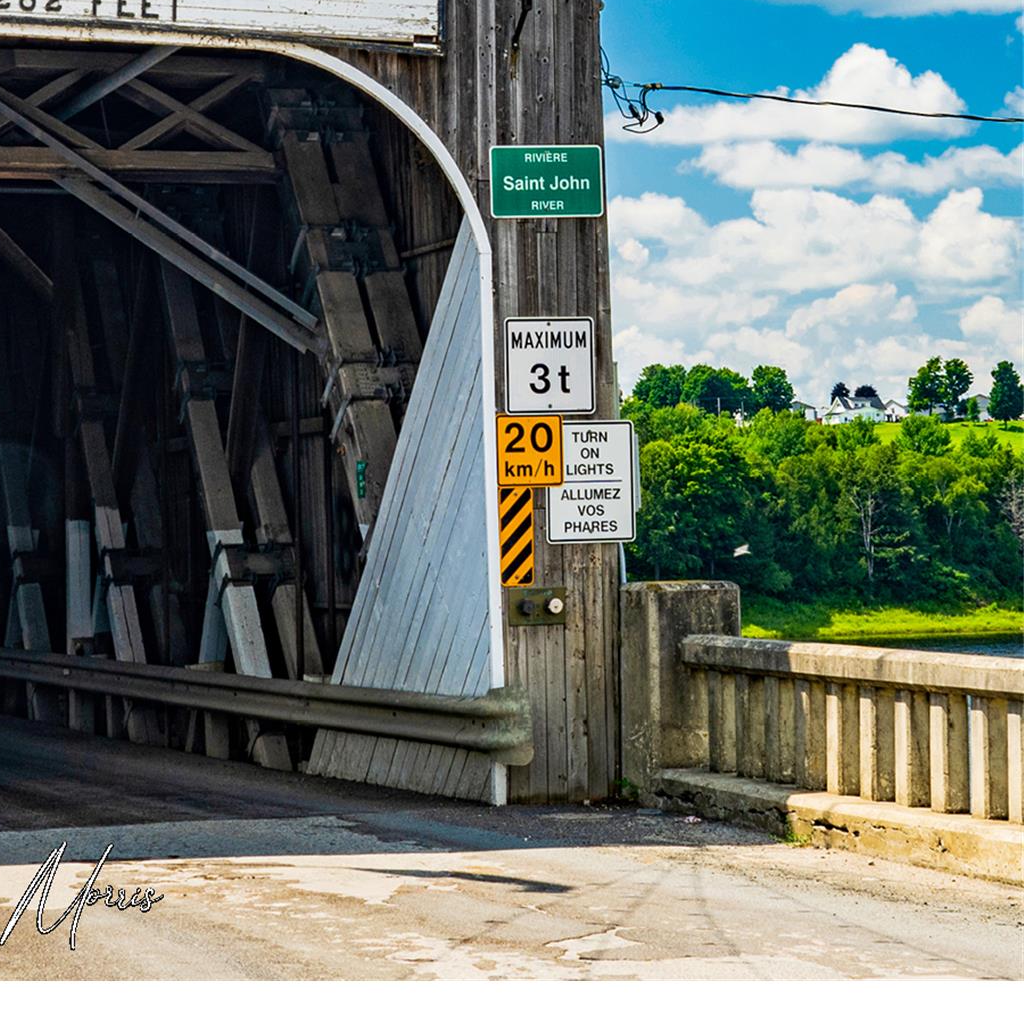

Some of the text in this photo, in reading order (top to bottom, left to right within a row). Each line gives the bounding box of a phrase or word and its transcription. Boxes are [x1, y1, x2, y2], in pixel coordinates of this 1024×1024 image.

[524, 151, 568, 163] RIVIÈRE
[503, 176, 590, 191] Saint John
[531, 200, 564, 210] RIVER
[511, 331, 587, 350] MAXIMUM
[505, 422, 553, 453] 20
[572, 431, 608, 443] TURN
[580, 448, 600, 459] ON
[505, 459, 554, 477] km/h
[566, 463, 614, 475] LIGHTS
[561, 488, 621, 501] ALLUMEZ
[578, 505, 605, 516] VOS
[564, 520, 618, 533] PHARES
